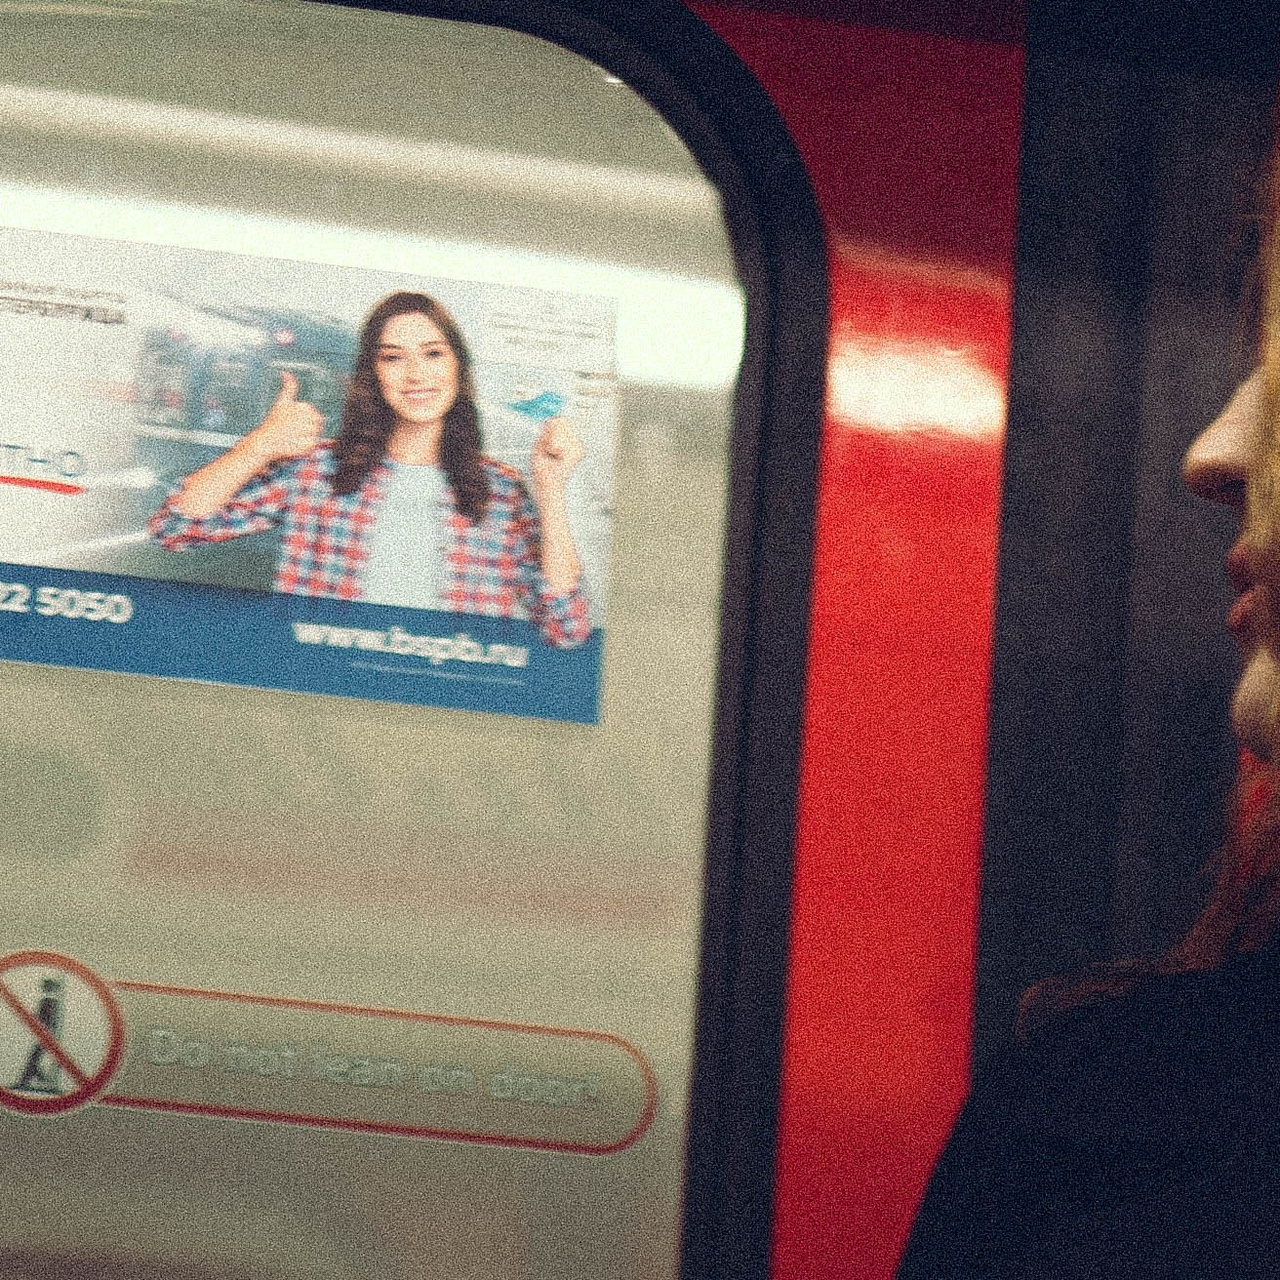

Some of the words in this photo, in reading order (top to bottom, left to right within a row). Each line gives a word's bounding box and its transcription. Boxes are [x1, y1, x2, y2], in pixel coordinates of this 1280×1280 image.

[0, 582, 29, 612] 2
[36, 585, 134, 624] 5050
[293, 622, 529, 667] www.bspb.ru
[148, 1027, 210, 1067] Do
[223, 1044, 298, 1078] not
[420, 1064, 474, 1093] on
